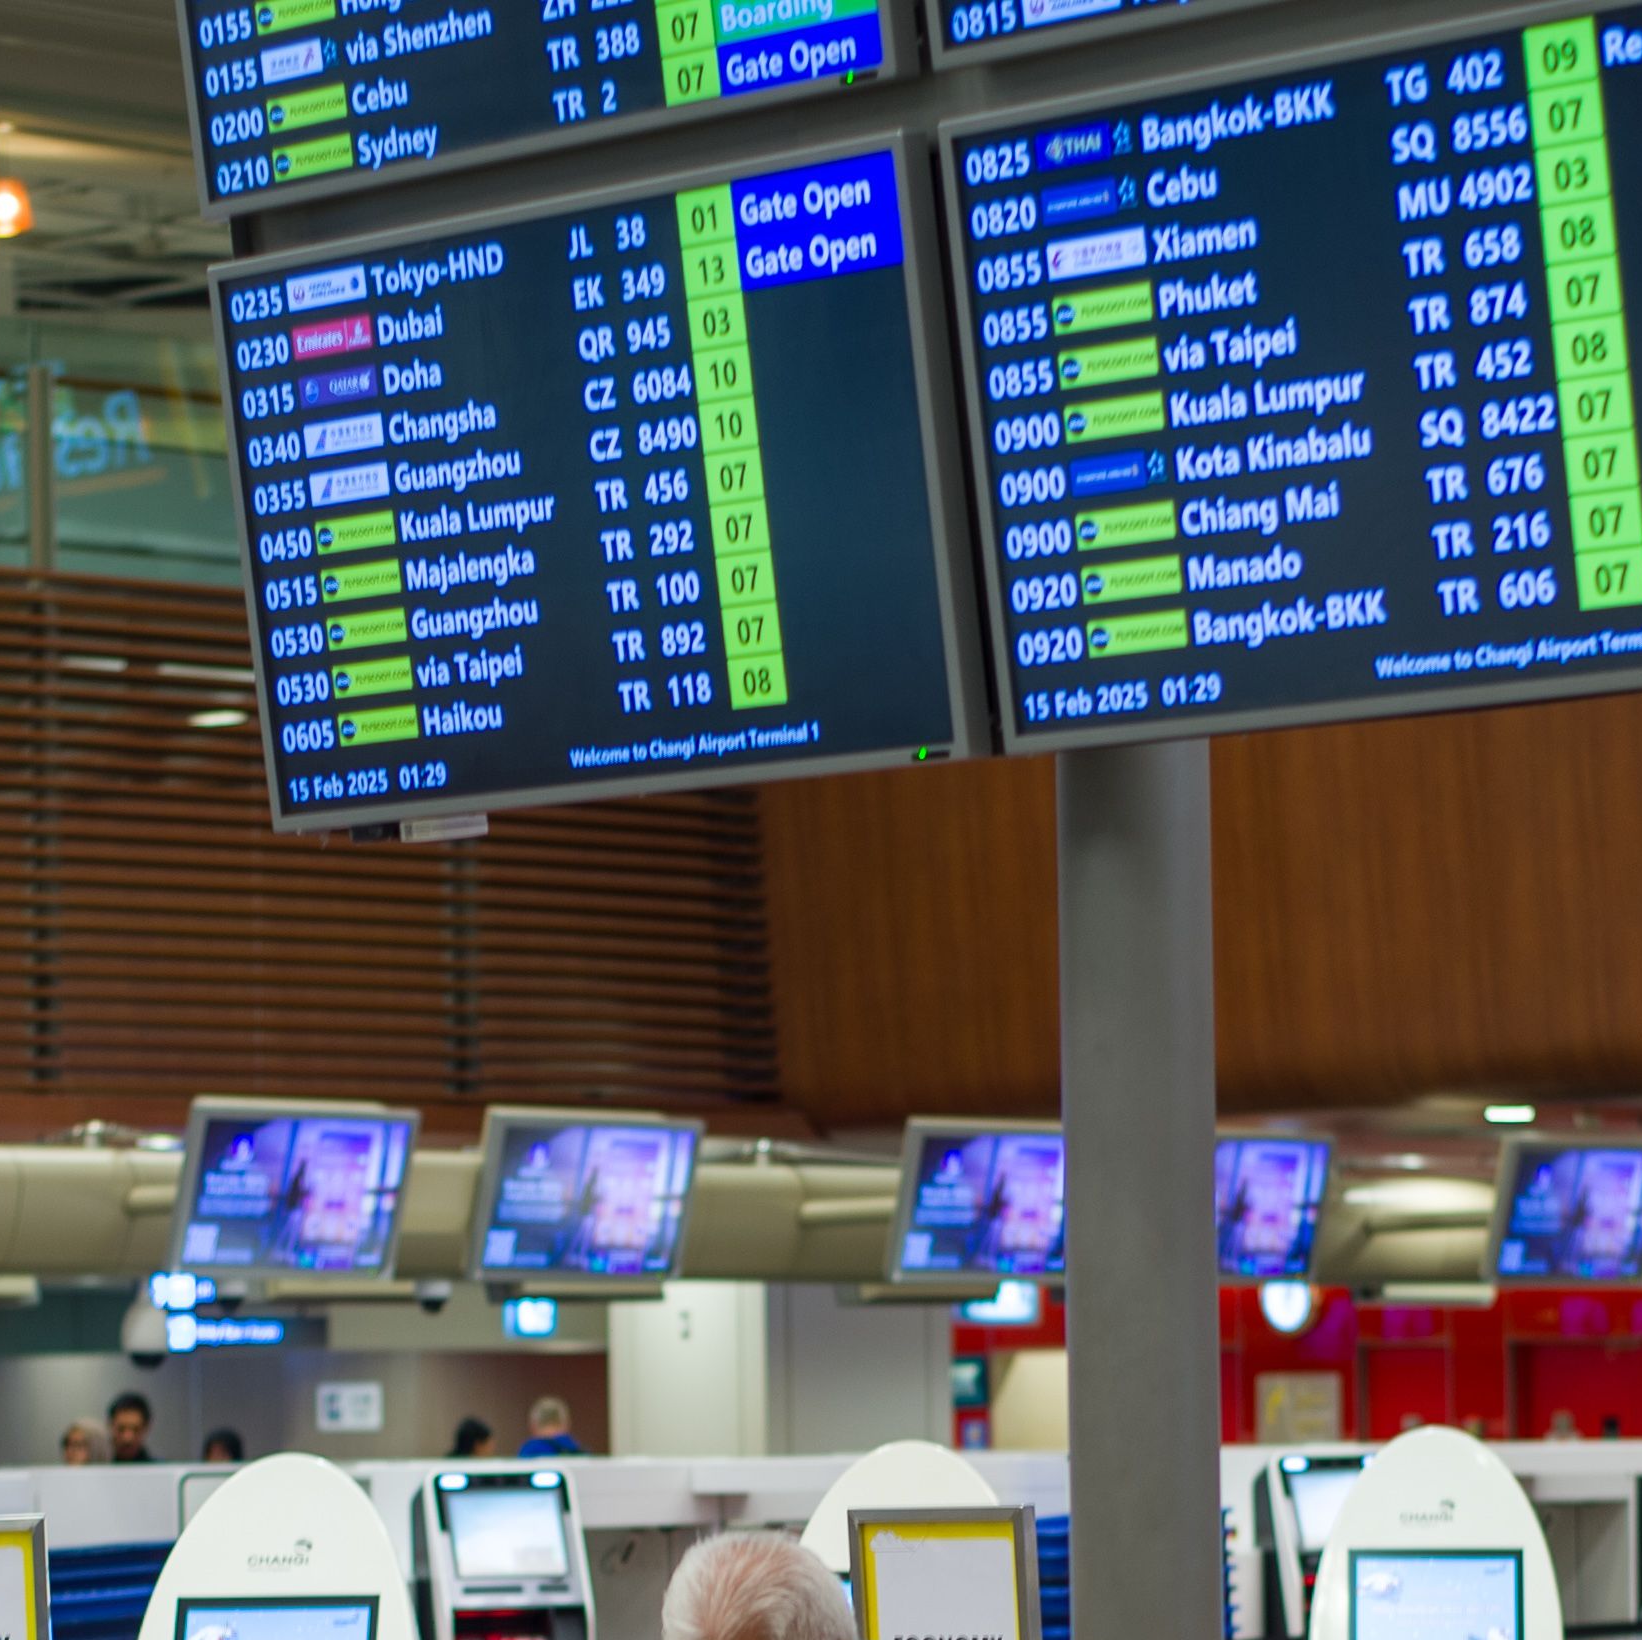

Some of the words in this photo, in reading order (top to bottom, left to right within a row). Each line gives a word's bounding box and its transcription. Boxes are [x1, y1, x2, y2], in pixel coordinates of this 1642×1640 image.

[200, 8, 252, 48] 0155
[206, 58, 257, 97] 0155
[345, 31, 379, 66] via
[383, 9, 492, 57] Shenzhen
[951, 2, 1016, 41] 0815
[211, 108, 264, 146] 0200
[352, 77, 408, 115] Cebu
[546, 37, 580, 71] TR
[596, 23, 640, 63] 388
[720, 0, 834, 32] Boarding
[217, 157, 269, 194] 0210
[357, 125, 437, 170] Sydney
[552, 87, 586, 123] TR
[601, 80, 617, 113] 2
[726, 52, 783, 86] Gate
[789, 37, 857, 78] Open
[966, 142, 1030, 183] 0825
[1141, 83, 1333, 151] Bangkok-BKK
[1386, 66, 1427, 104] TG
[1448, 52, 1502, 92] 402
[971, 196, 1036, 238] 0820
[1147, 166, 1217, 206] Cebu
[1391, 123, 1435, 163] SQ
[1453, 106, 1527, 151] 8556
[231, 285, 283, 322] 0235
[370, 244, 503, 296] Tokyo-HND
[569, 227, 593, 259] JL
[616, 216, 646, 250] 38
[739, 191, 797, 226] Gate
[803, 179, 871, 218] Open
[977, 250, 1042, 292] 0855
[1152, 220, 1256, 263] Xiamen
[1398, 178, 1450, 220] MU
[1459, 164, 1532, 208] 4902
[237, 334, 289, 370] 0230
[377, 304, 443, 345] Dubai
[573, 275, 604, 310] EK
[621, 264, 665, 301] 349
[745, 244, 803, 278] Gate
[808, 232, 877, 271] Open
[983, 305, 1048, 346] 0855
[1158, 272, 1257, 317] Phuket
[1402, 239, 1444, 277] TR
[1465, 225, 1521, 267] 658
[242, 383, 294, 419] 0315
[382, 358, 442, 394] Doha
[578, 326, 615, 362] QR
[626, 315, 670, 352] 945
[989, 358, 1053, 399] 0855
[1163, 335, 1205, 372] via
[1209, 318, 1296, 367] Taipei
[1408, 295, 1450, 333] TR
[1470, 282, 1526, 324] 874
[248, 431, 300, 467] 0340
[388, 399, 496, 443] Changsha
[584, 377, 616, 411] CZ
[632, 364, 691, 403] 6084
[994, 412, 1060, 453] 0900
[1170, 383, 1247, 426] Kuala
[1253, 372, 1364, 414] Lumpur
[1414, 352, 1455, 390] TR
[1476, 340, 1531, 380] 452
[254, 479, 306, 515] 0355
[394, 448, 521, 492] Guangzhou
[589, 427, 622, 461] CZ
[638, 416, 697, 454] 8490
[1000, 466, 1066, 506] 0900
[1175, 445, 1241, 481] Kota
[1247, 422, 1371, 471] Kinabalu
[1420, 408, 1464, 447] SQ
[1482, 395, 1555, 438] 8422
[259, 527, 312, 562] 0450
[399, 504, 462, 542] Kuala
[466, 496, 554, 533] Lumpur
[594, 479, 628, 512] TR
[644, 469, 688, 504] 456
[1006, 519, 1071, 559] 0900
[1181, 496, 1279, 535] Chiang
[1285, 481, 1339, 522] Mai
[1426, 465, 1467, 502] TR
[1487, 454, 1544, 494] 676
[265, 575, 317, 610] 0515
[405, 544, 534, 594] Majalengka
[600, 529, 633, 562] TR
[649, 520, 694, 555] 292
[1012, 573, 1077, 612] 0920
[1187, 545, 1302, 590] Manado
[1431, 522, 1473, 558] TR
[1493, 511, 1550, 551] 216
[271, 623, 323, 657] 0530
[411, 597, 538, 639] Guangzhou
[606, 579, 639, 612] TR
[656, 570, 700, 605] 100
[277, 671, 329, 705] 0530
[416, 655, 450, 687] via
[453, 644, 522, 686] Taipei
[611, 630, 645, 662] TR
[661, 621, 705, 656] 892
[1017, 626, 1083, 665] 0920
[1193, 589, 1386, 647] Bangkok-BKK
[1437, 578, 1479, 614] TR
[1499, 568, 1556, 608] 606
[282, 719, 334, 752] 0605
[424, 701, 502, 736] Haikou
[618, 680, 651, 712] TR
[668, 672, 711, 706] 118
[570, 747, 630, 767] Welcome
[632, 744, 647, 761] to
[649, 735, 695, 760] Changi
[698, 731, 746, 755] Airport
[748, 722, 808, 747] Terminal
[811, 721, 819, 740] 1
[289, 778, 309, 802] 15
[313, 773, 344, 799] Feb
[347, 769, 388, 795] 2025
[399, 762, 446, 789] 01:29
[247, 1555, 309, 1568] CHANGI
